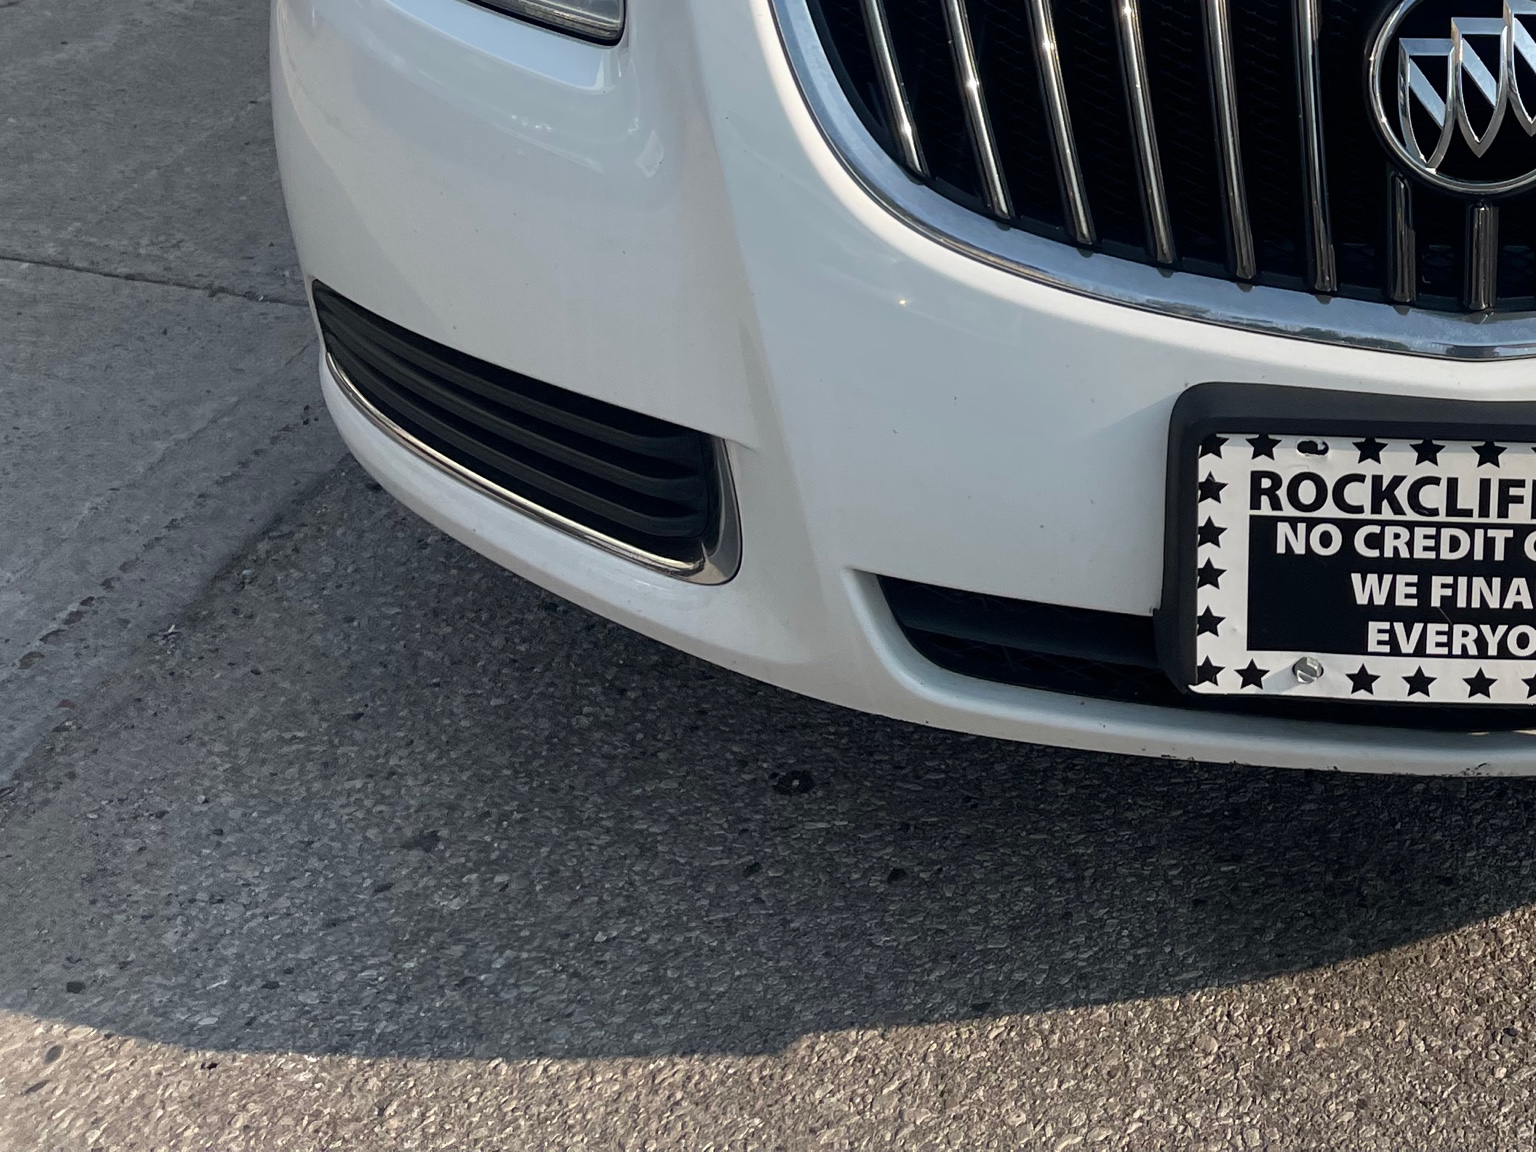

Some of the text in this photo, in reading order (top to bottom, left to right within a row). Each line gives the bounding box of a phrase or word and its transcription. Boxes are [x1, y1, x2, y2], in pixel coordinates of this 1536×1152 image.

[1275, 522, 1343, 559] NO
[1353, 525, 1514, 563] CREDIT
[1350, 572, 1418, 607] WE
